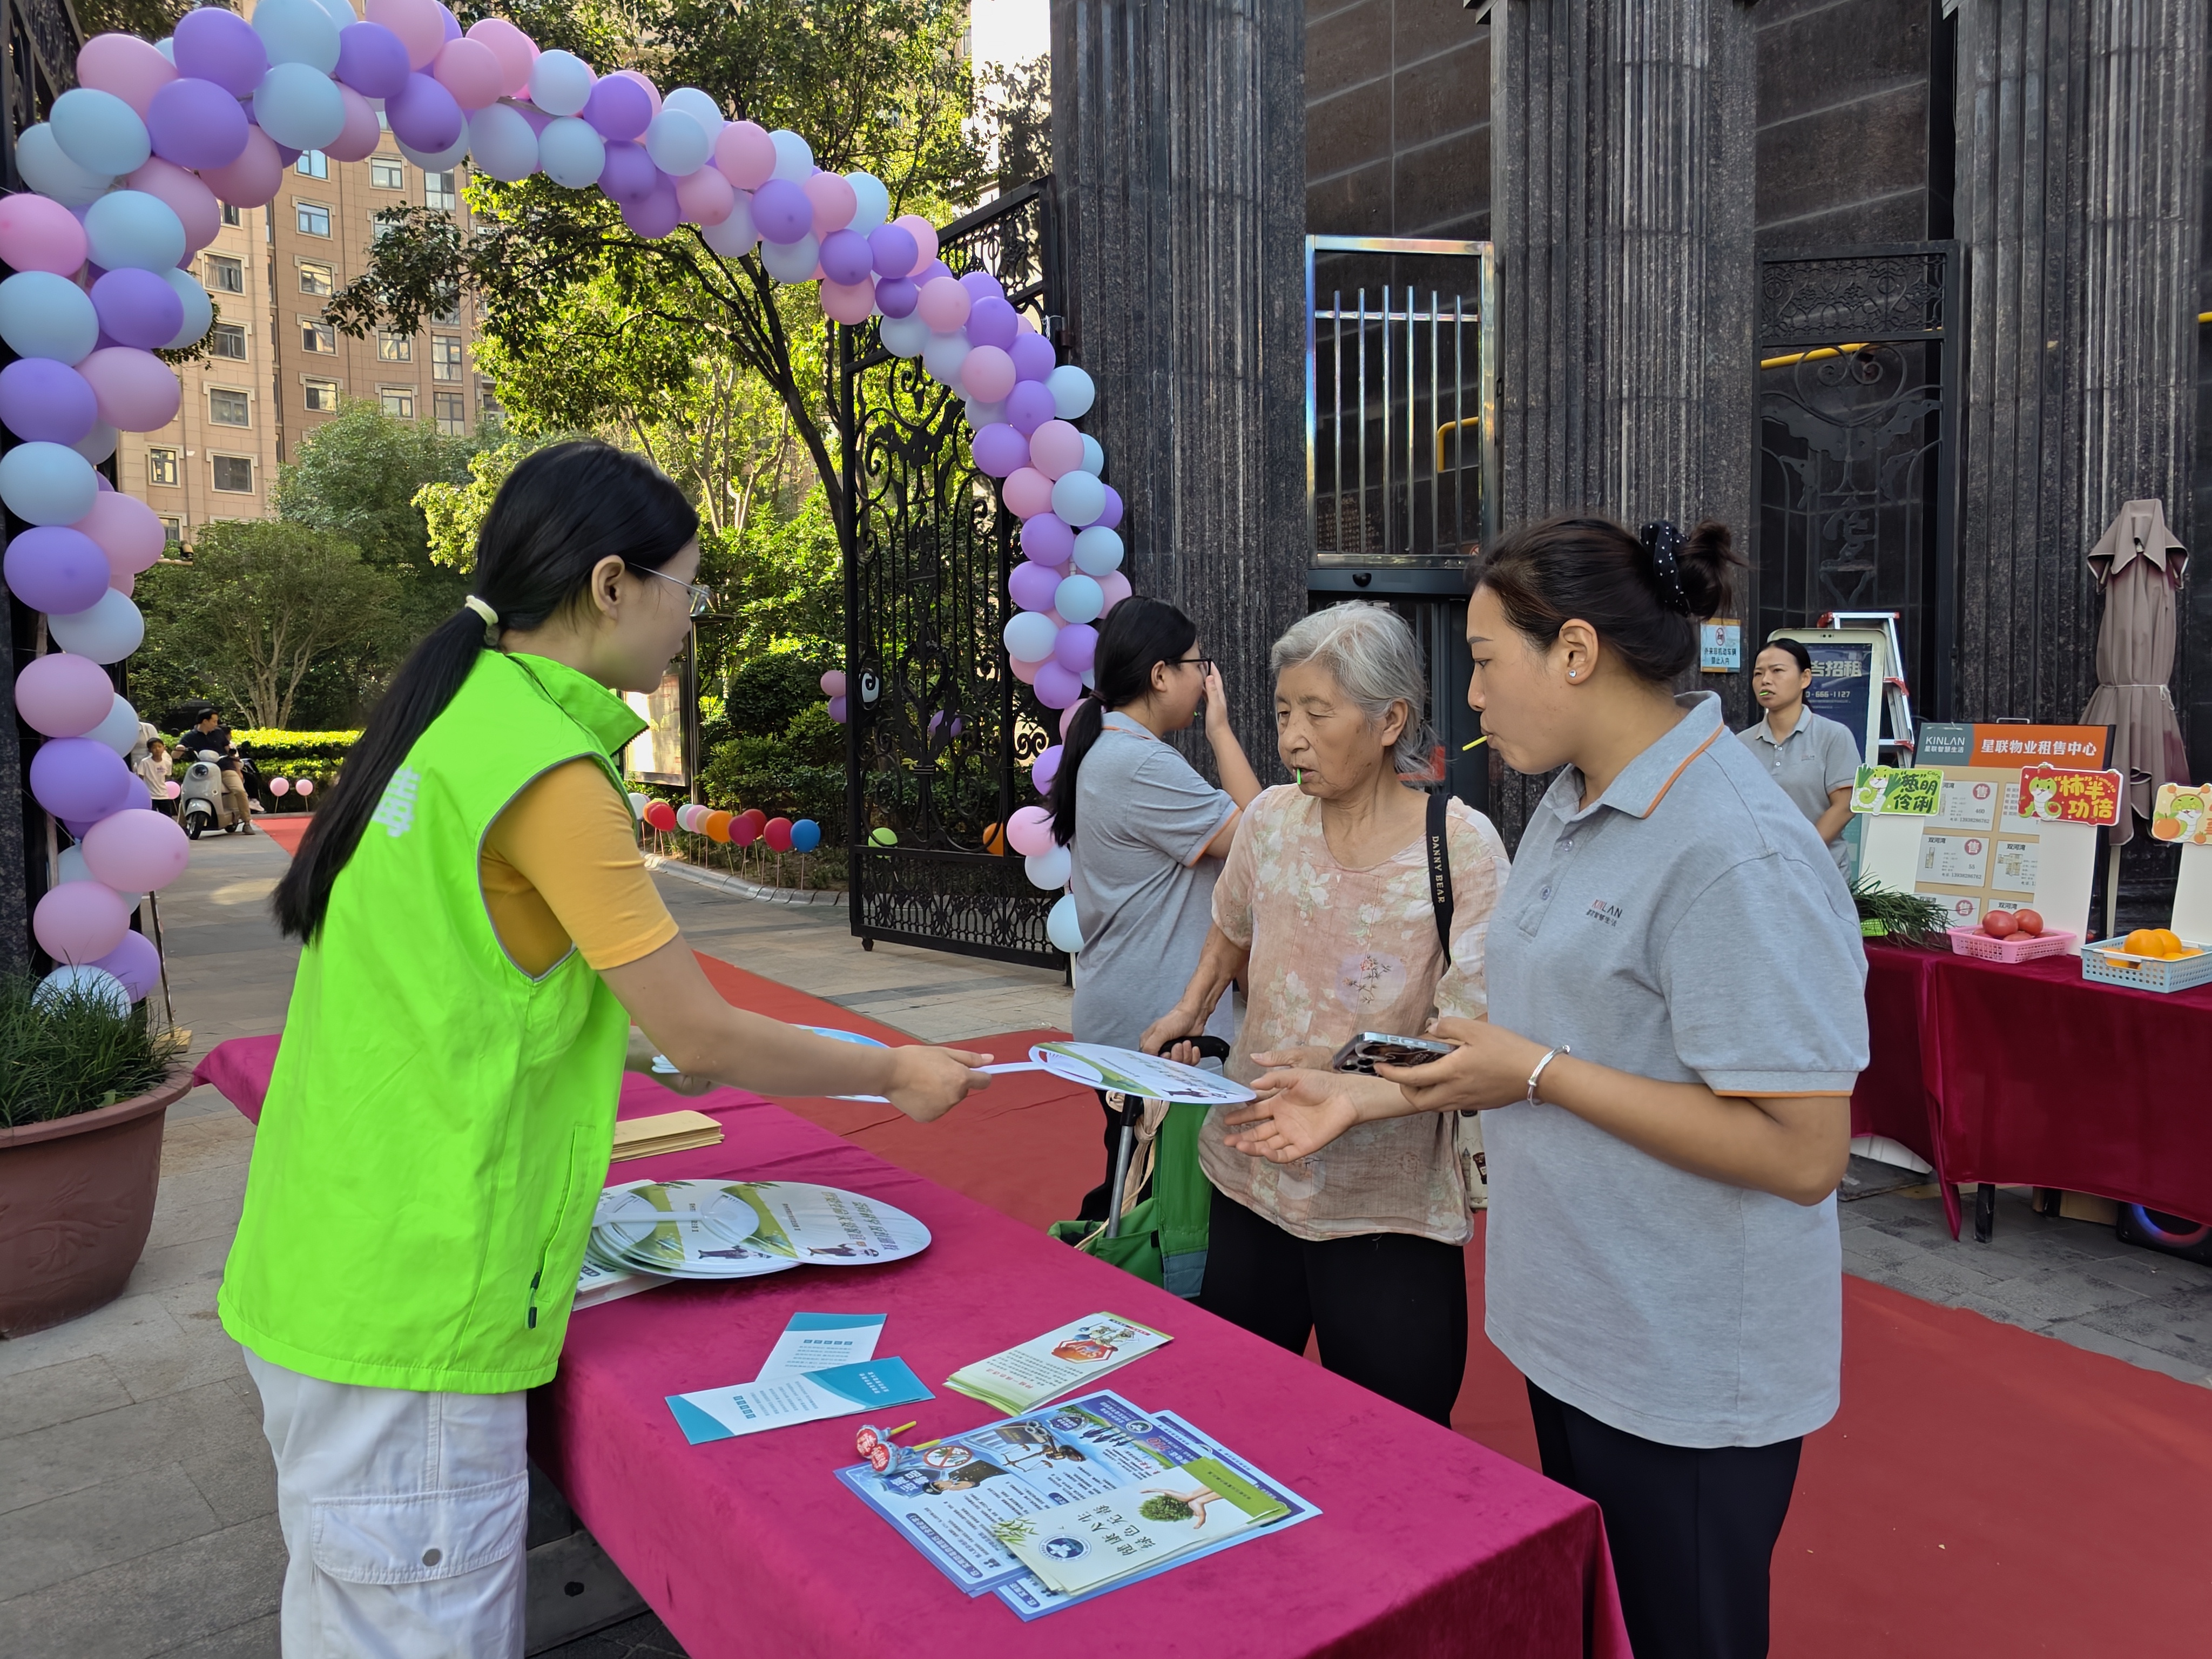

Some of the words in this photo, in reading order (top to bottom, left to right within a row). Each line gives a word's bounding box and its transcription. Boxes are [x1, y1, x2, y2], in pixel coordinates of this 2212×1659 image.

[1925, 736, 1965, 745] KINLAN
[1981, 739, 2097, 756] 星联物业租售中心
[1927, 771, 1941, 779] Corn
[2095, 775, 2116, 793] Tomato
[1893, 794, 1933, 813] 伶俐
[2068, 798, 2114, 819] 功倍
[1432, 835, 1442, 871] DANNY
[1435, 874, 1445, 903] BEAR
[1591, 899, 1622, 918] KINLAN
[1147, 1437, 1171, 1452] 110
[901, 1475, 929, 1492] 远离
[1078, 1511, 1137, 1555] 健康人生
[1094, 1505, 1156, 1548] 绿色无毒
